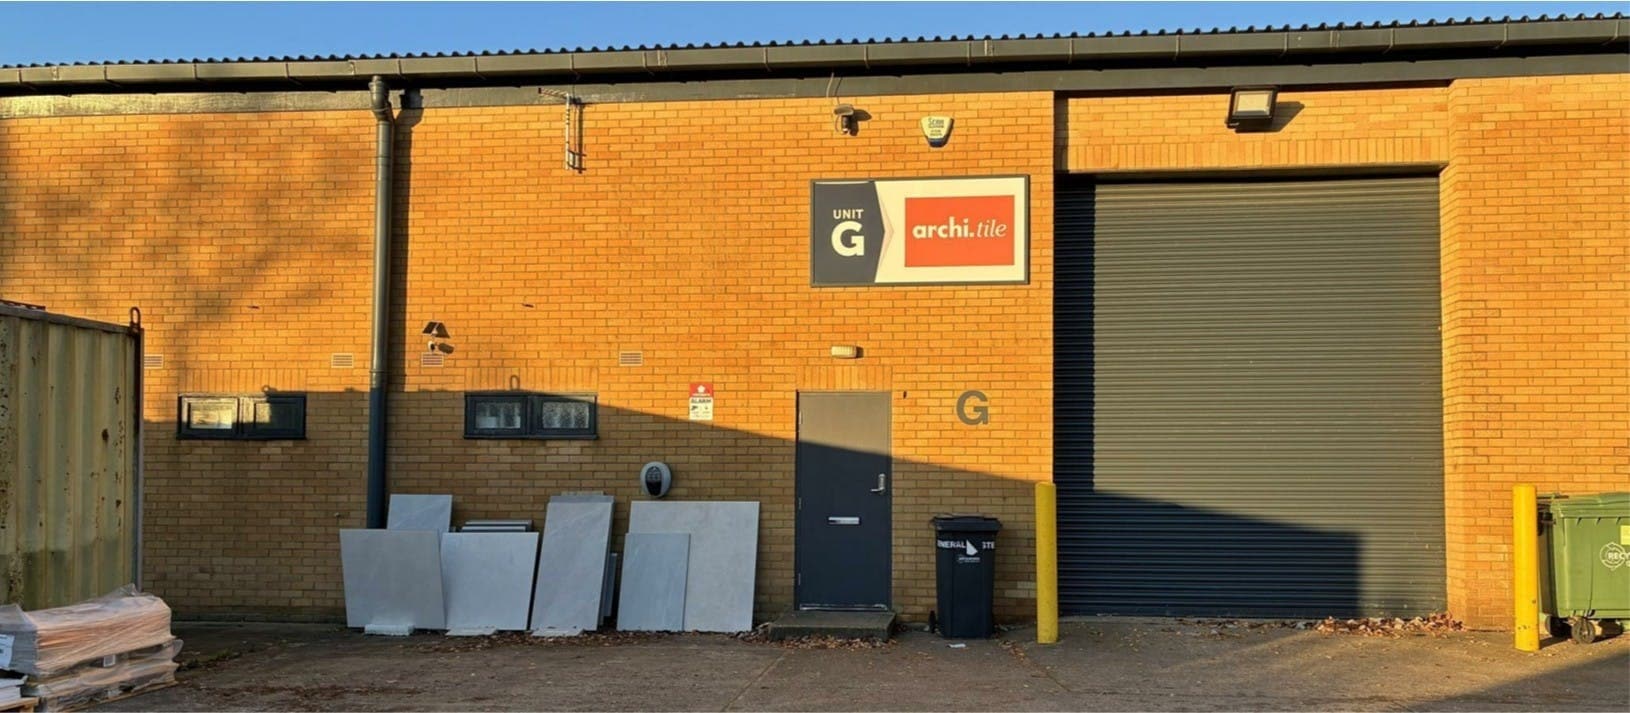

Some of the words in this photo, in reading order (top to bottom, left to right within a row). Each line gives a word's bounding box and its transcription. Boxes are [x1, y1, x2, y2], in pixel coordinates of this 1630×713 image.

[833, 209, 864, 219] UNIT
[912, 216, 1007, 239] archi.tile
[831, 221, 865, 257] G
[956, 390, 989, 425] G
